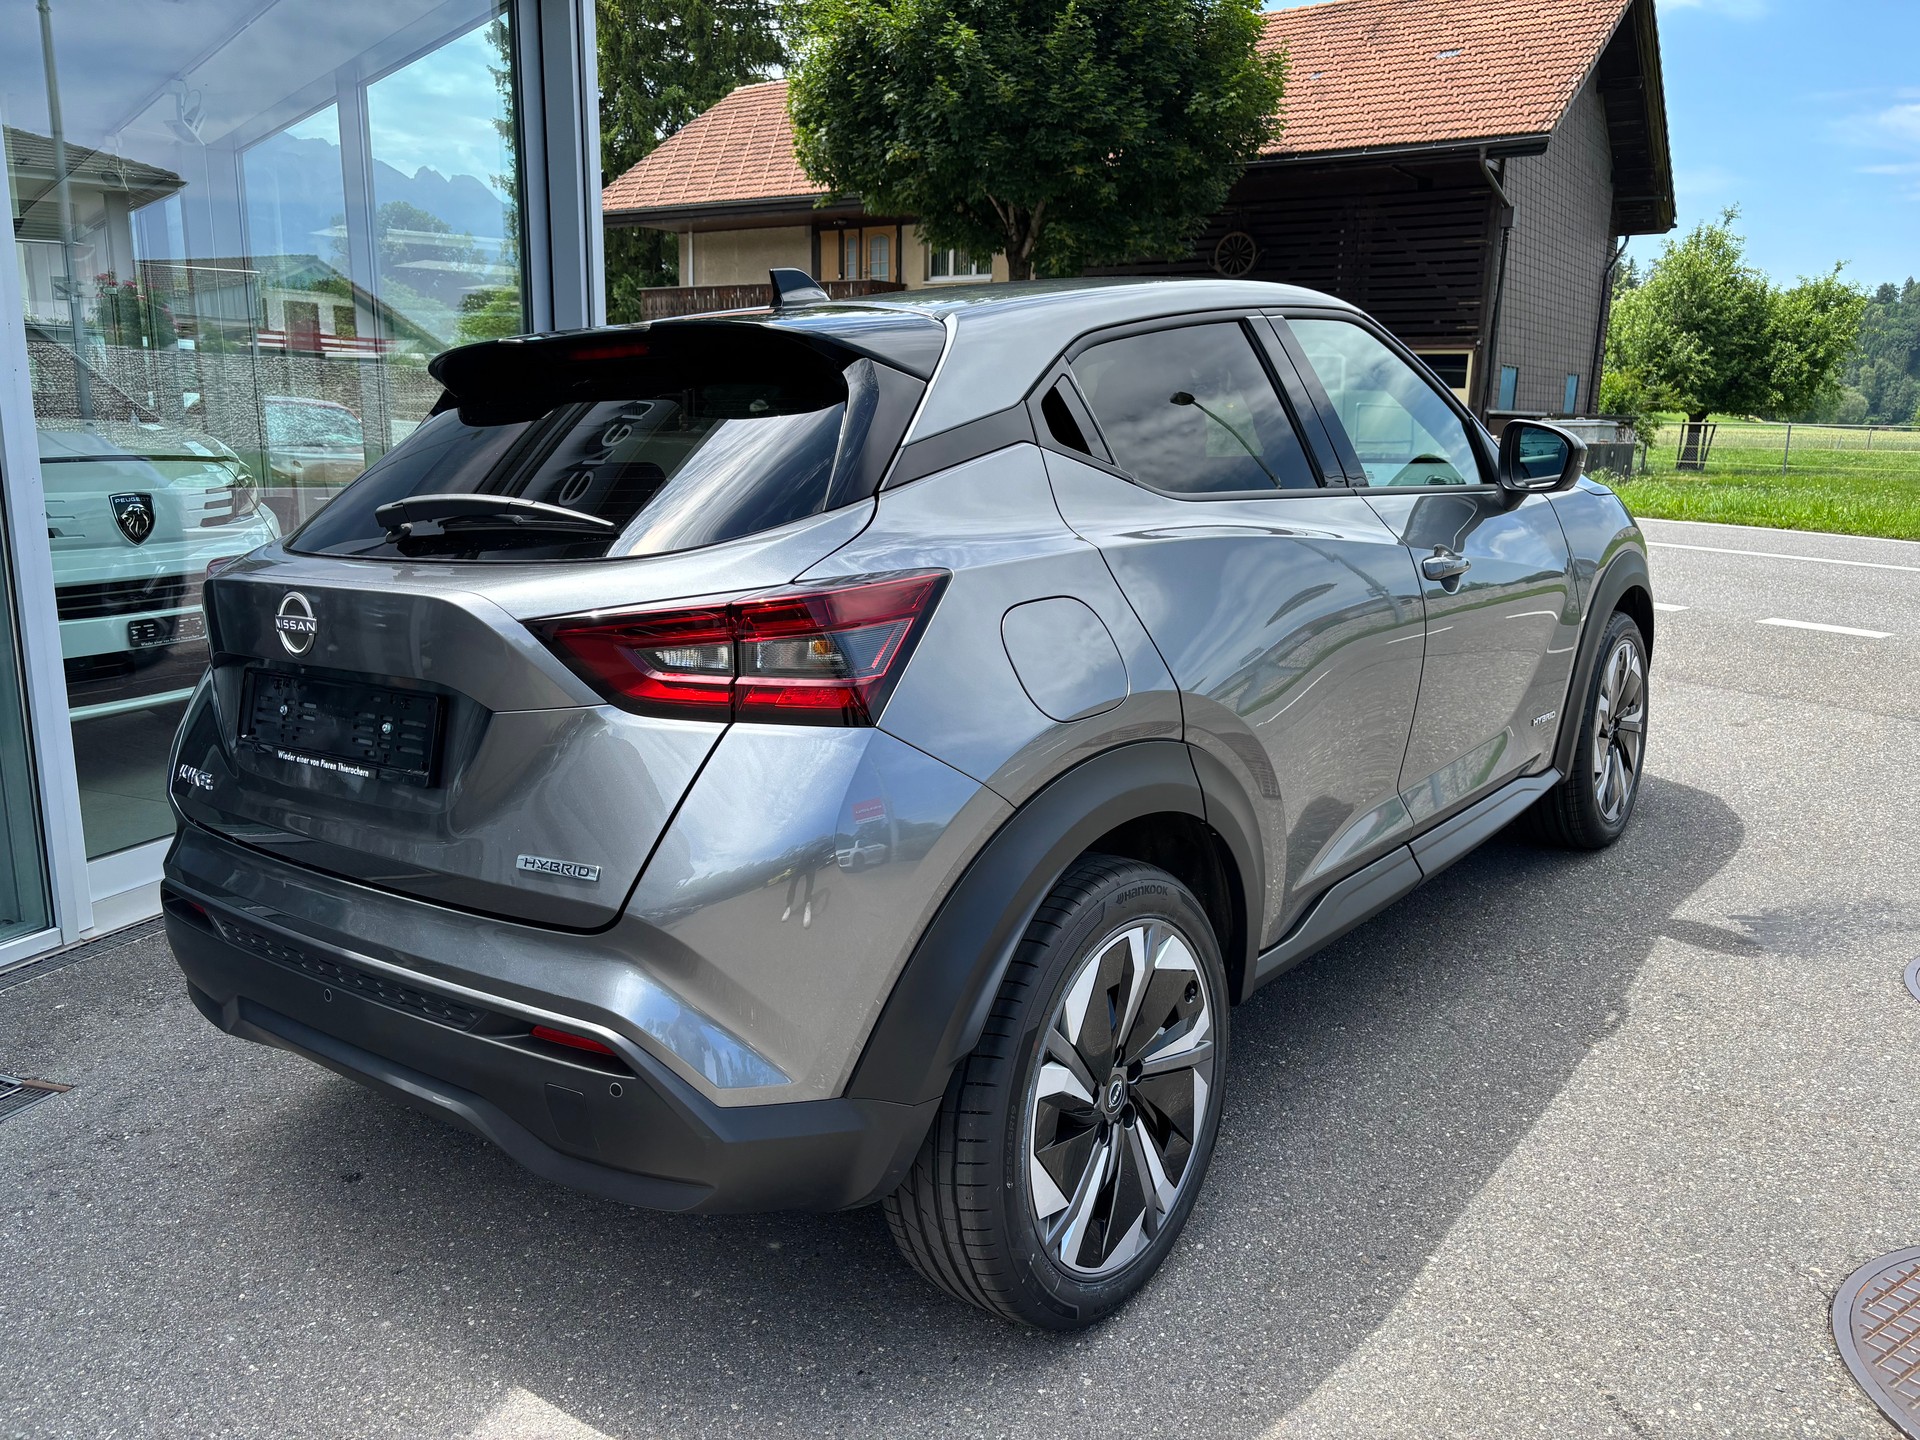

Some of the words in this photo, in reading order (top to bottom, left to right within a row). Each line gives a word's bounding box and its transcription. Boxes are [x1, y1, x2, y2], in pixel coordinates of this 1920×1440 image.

[115, 496, 150, 504] PEUGEOT
[276, 618, 316, 632] NISSAN
[1533, 710, 1556, 727] HYBRID
[277, 749, 296, 762] Wieder
[296, 755, 310, 765] einer
[310, 759, 320, 767] von
[320, 758, 337, 771] Pieren
[174, 763, 214, 791] JUKE
[523, 857, 590, 878] HYBRID
